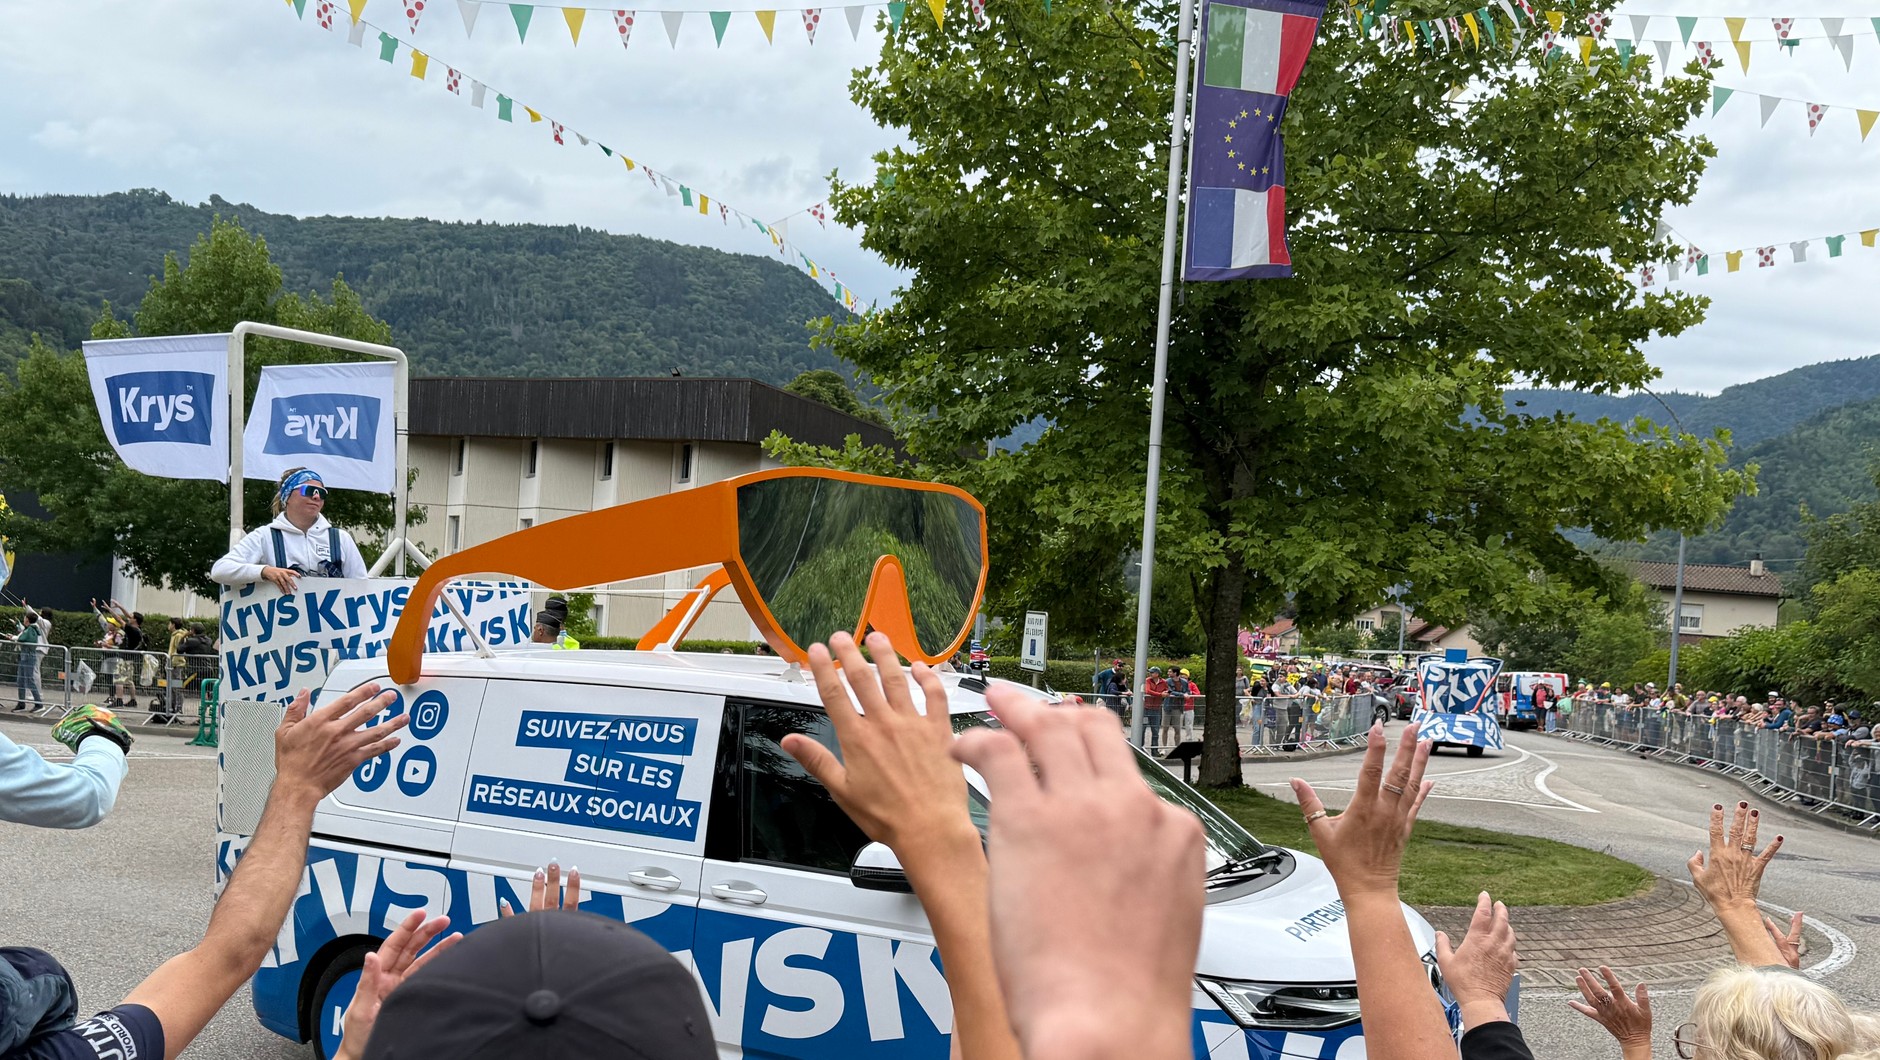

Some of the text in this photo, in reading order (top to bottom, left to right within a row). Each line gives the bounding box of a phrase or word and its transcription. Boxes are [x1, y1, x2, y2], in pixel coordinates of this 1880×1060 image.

[118, 386, 195, 431] Krys
[304, 586, 410, 634] Krys
[226, 640, 320, 691] Krys
[525, 718, 685, 744] SUIVEZ-NOUS
[574, 753, 674, 789] SUR LES
[473, 781, 695, 828] RÉSEAUX SOCIAUX
[111, 1023, 135, 1058] WORLD
